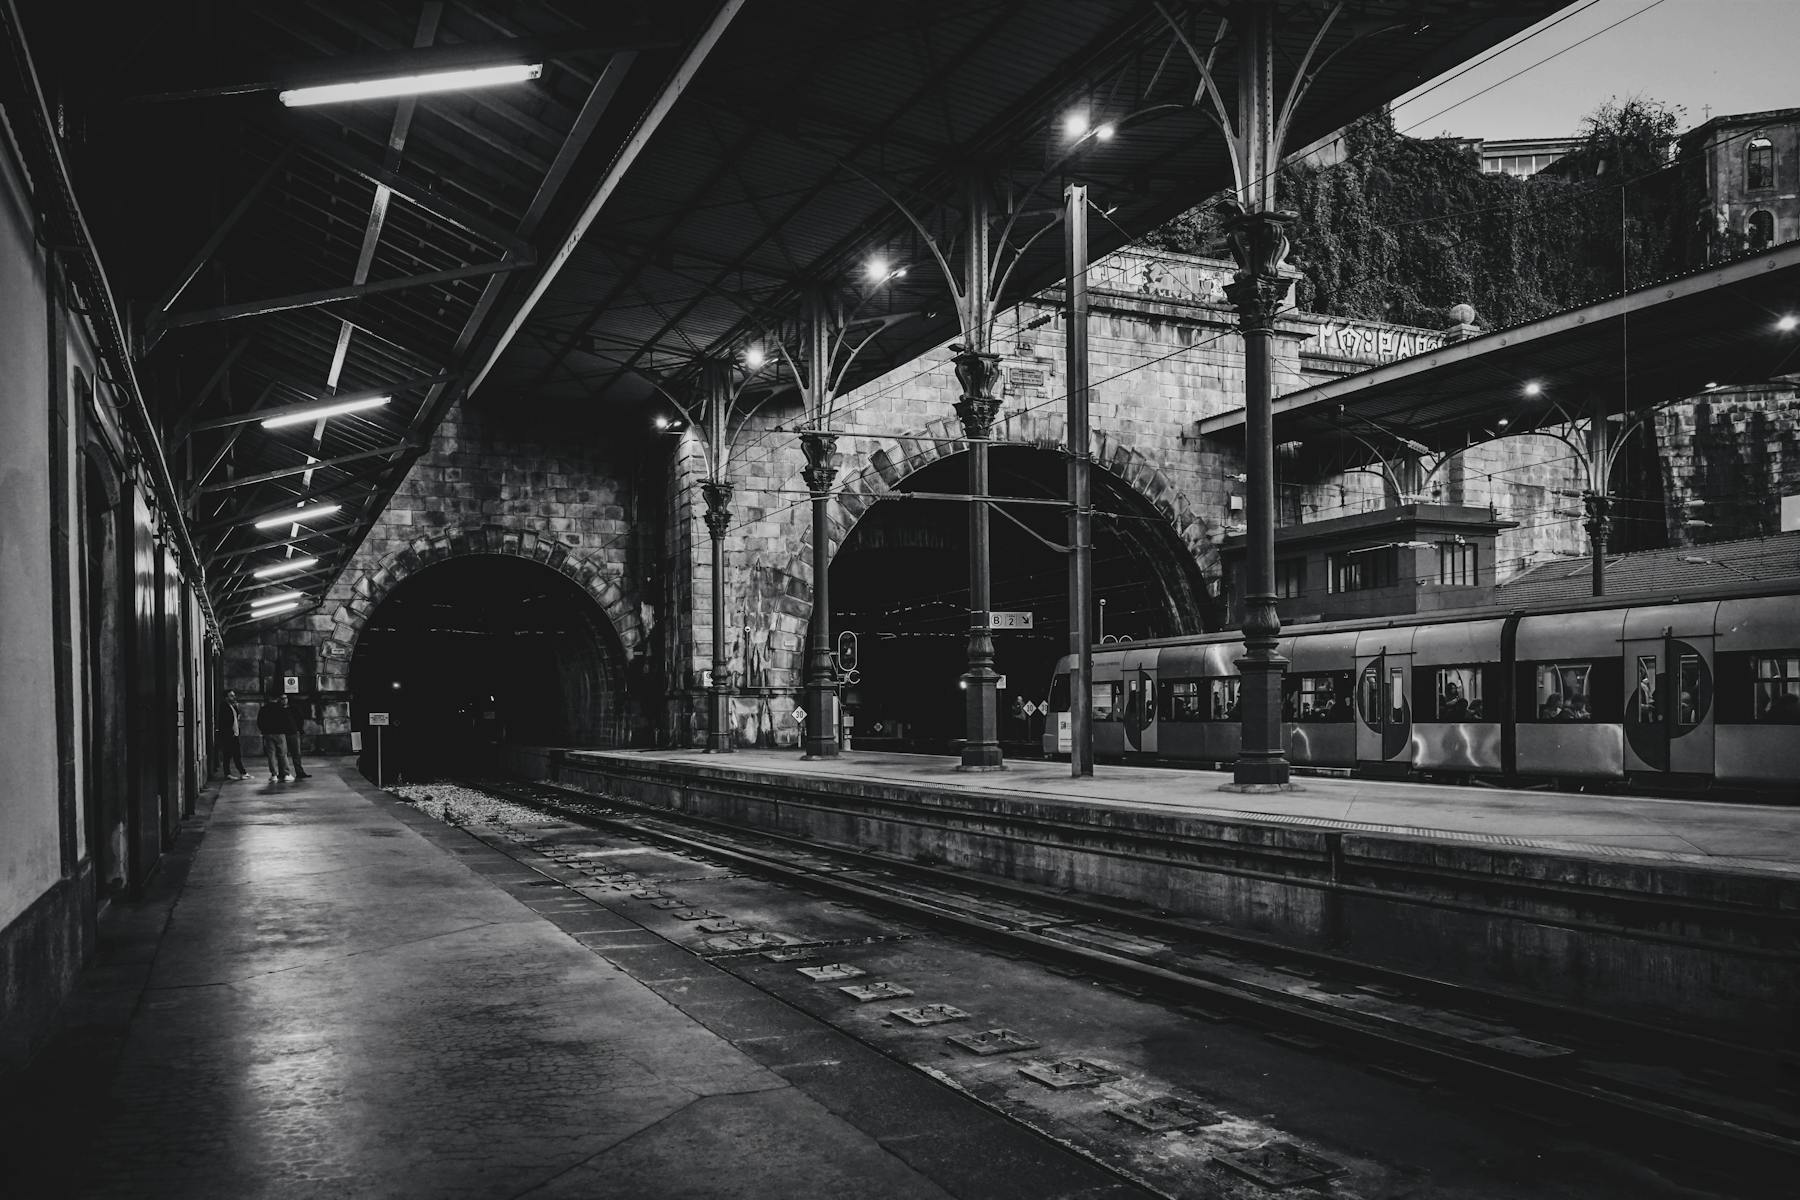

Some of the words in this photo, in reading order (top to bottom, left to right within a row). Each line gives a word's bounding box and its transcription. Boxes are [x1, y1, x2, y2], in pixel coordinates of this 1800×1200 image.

[993, 616, 1000, 625] B
[1008, 617, 1014, 626] 2
[795, 710, 804, 719] 30
